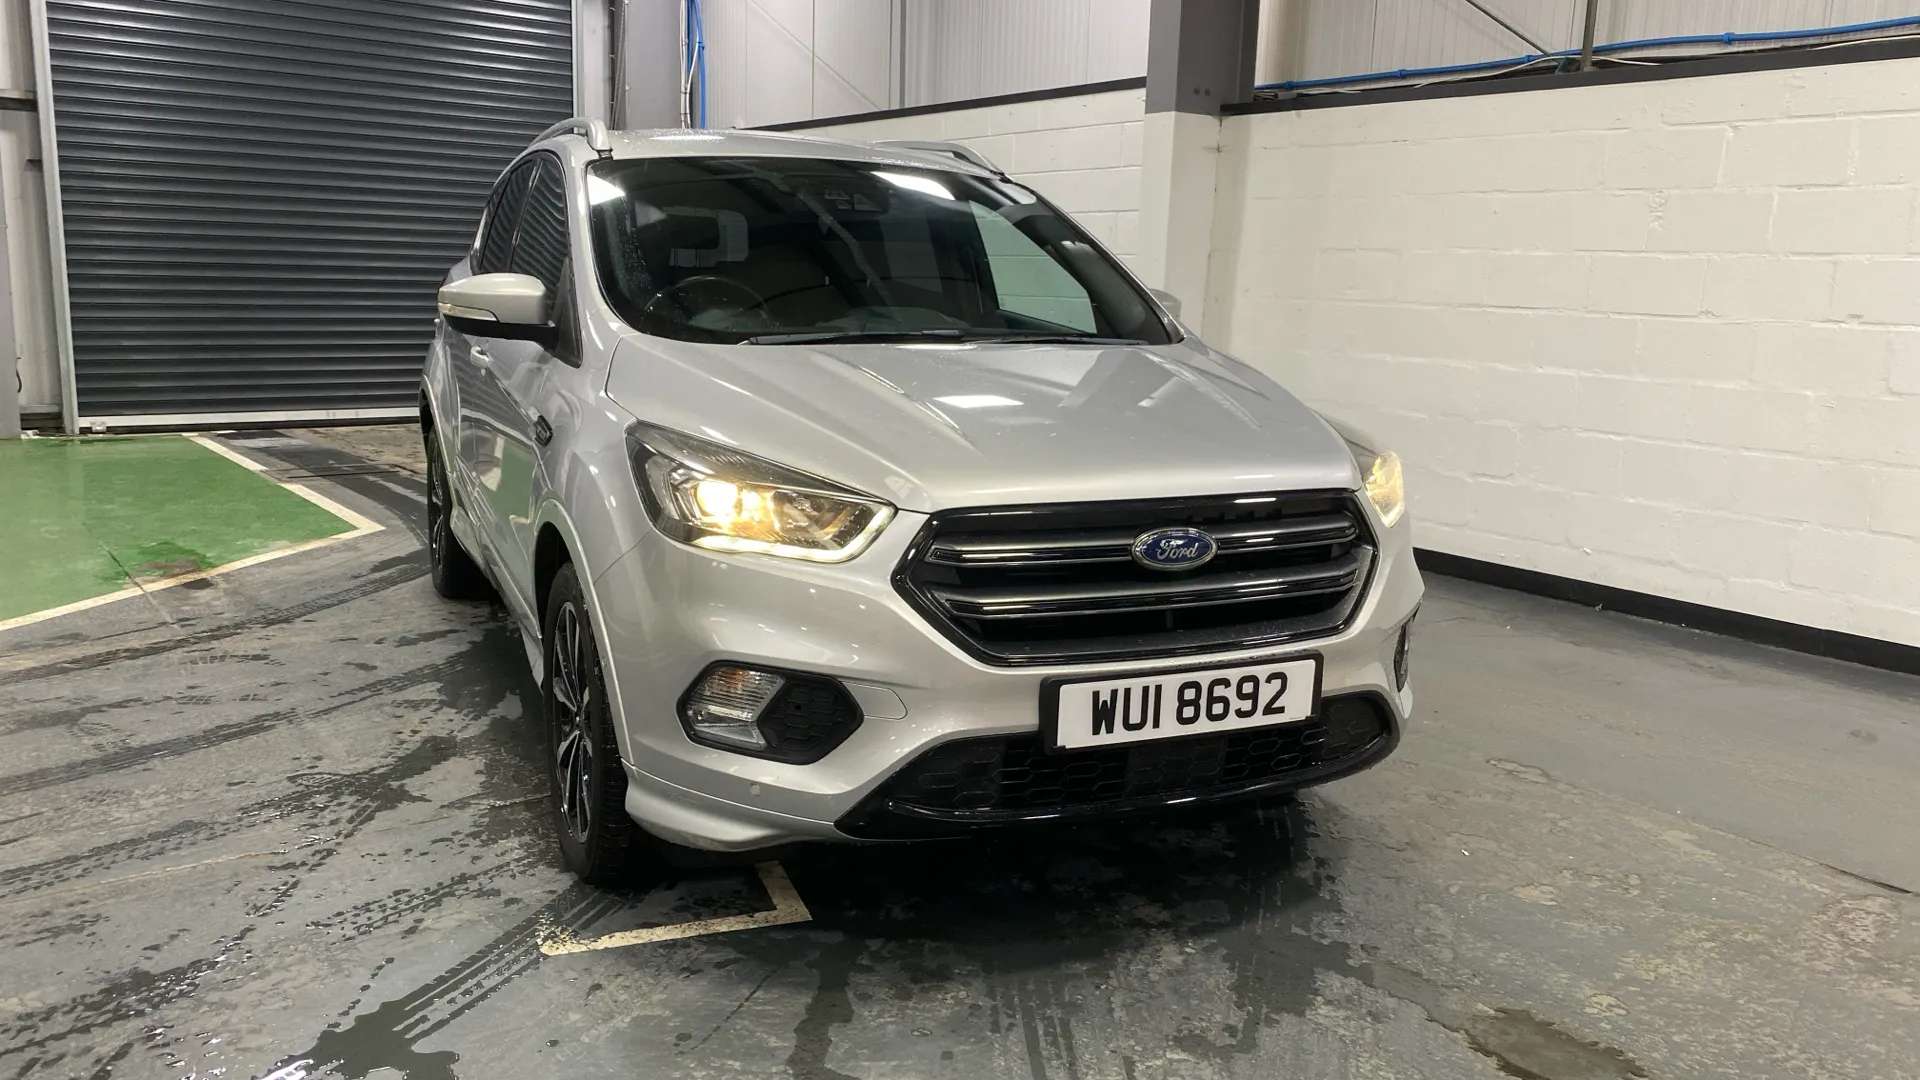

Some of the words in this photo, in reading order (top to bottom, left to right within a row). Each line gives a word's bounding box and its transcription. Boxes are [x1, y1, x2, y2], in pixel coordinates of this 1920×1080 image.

[1156, 539, 1199, 560] Ford
[1091, 684, 1162, 736] WUI
[1176, 671, 1288, 725] 8692
